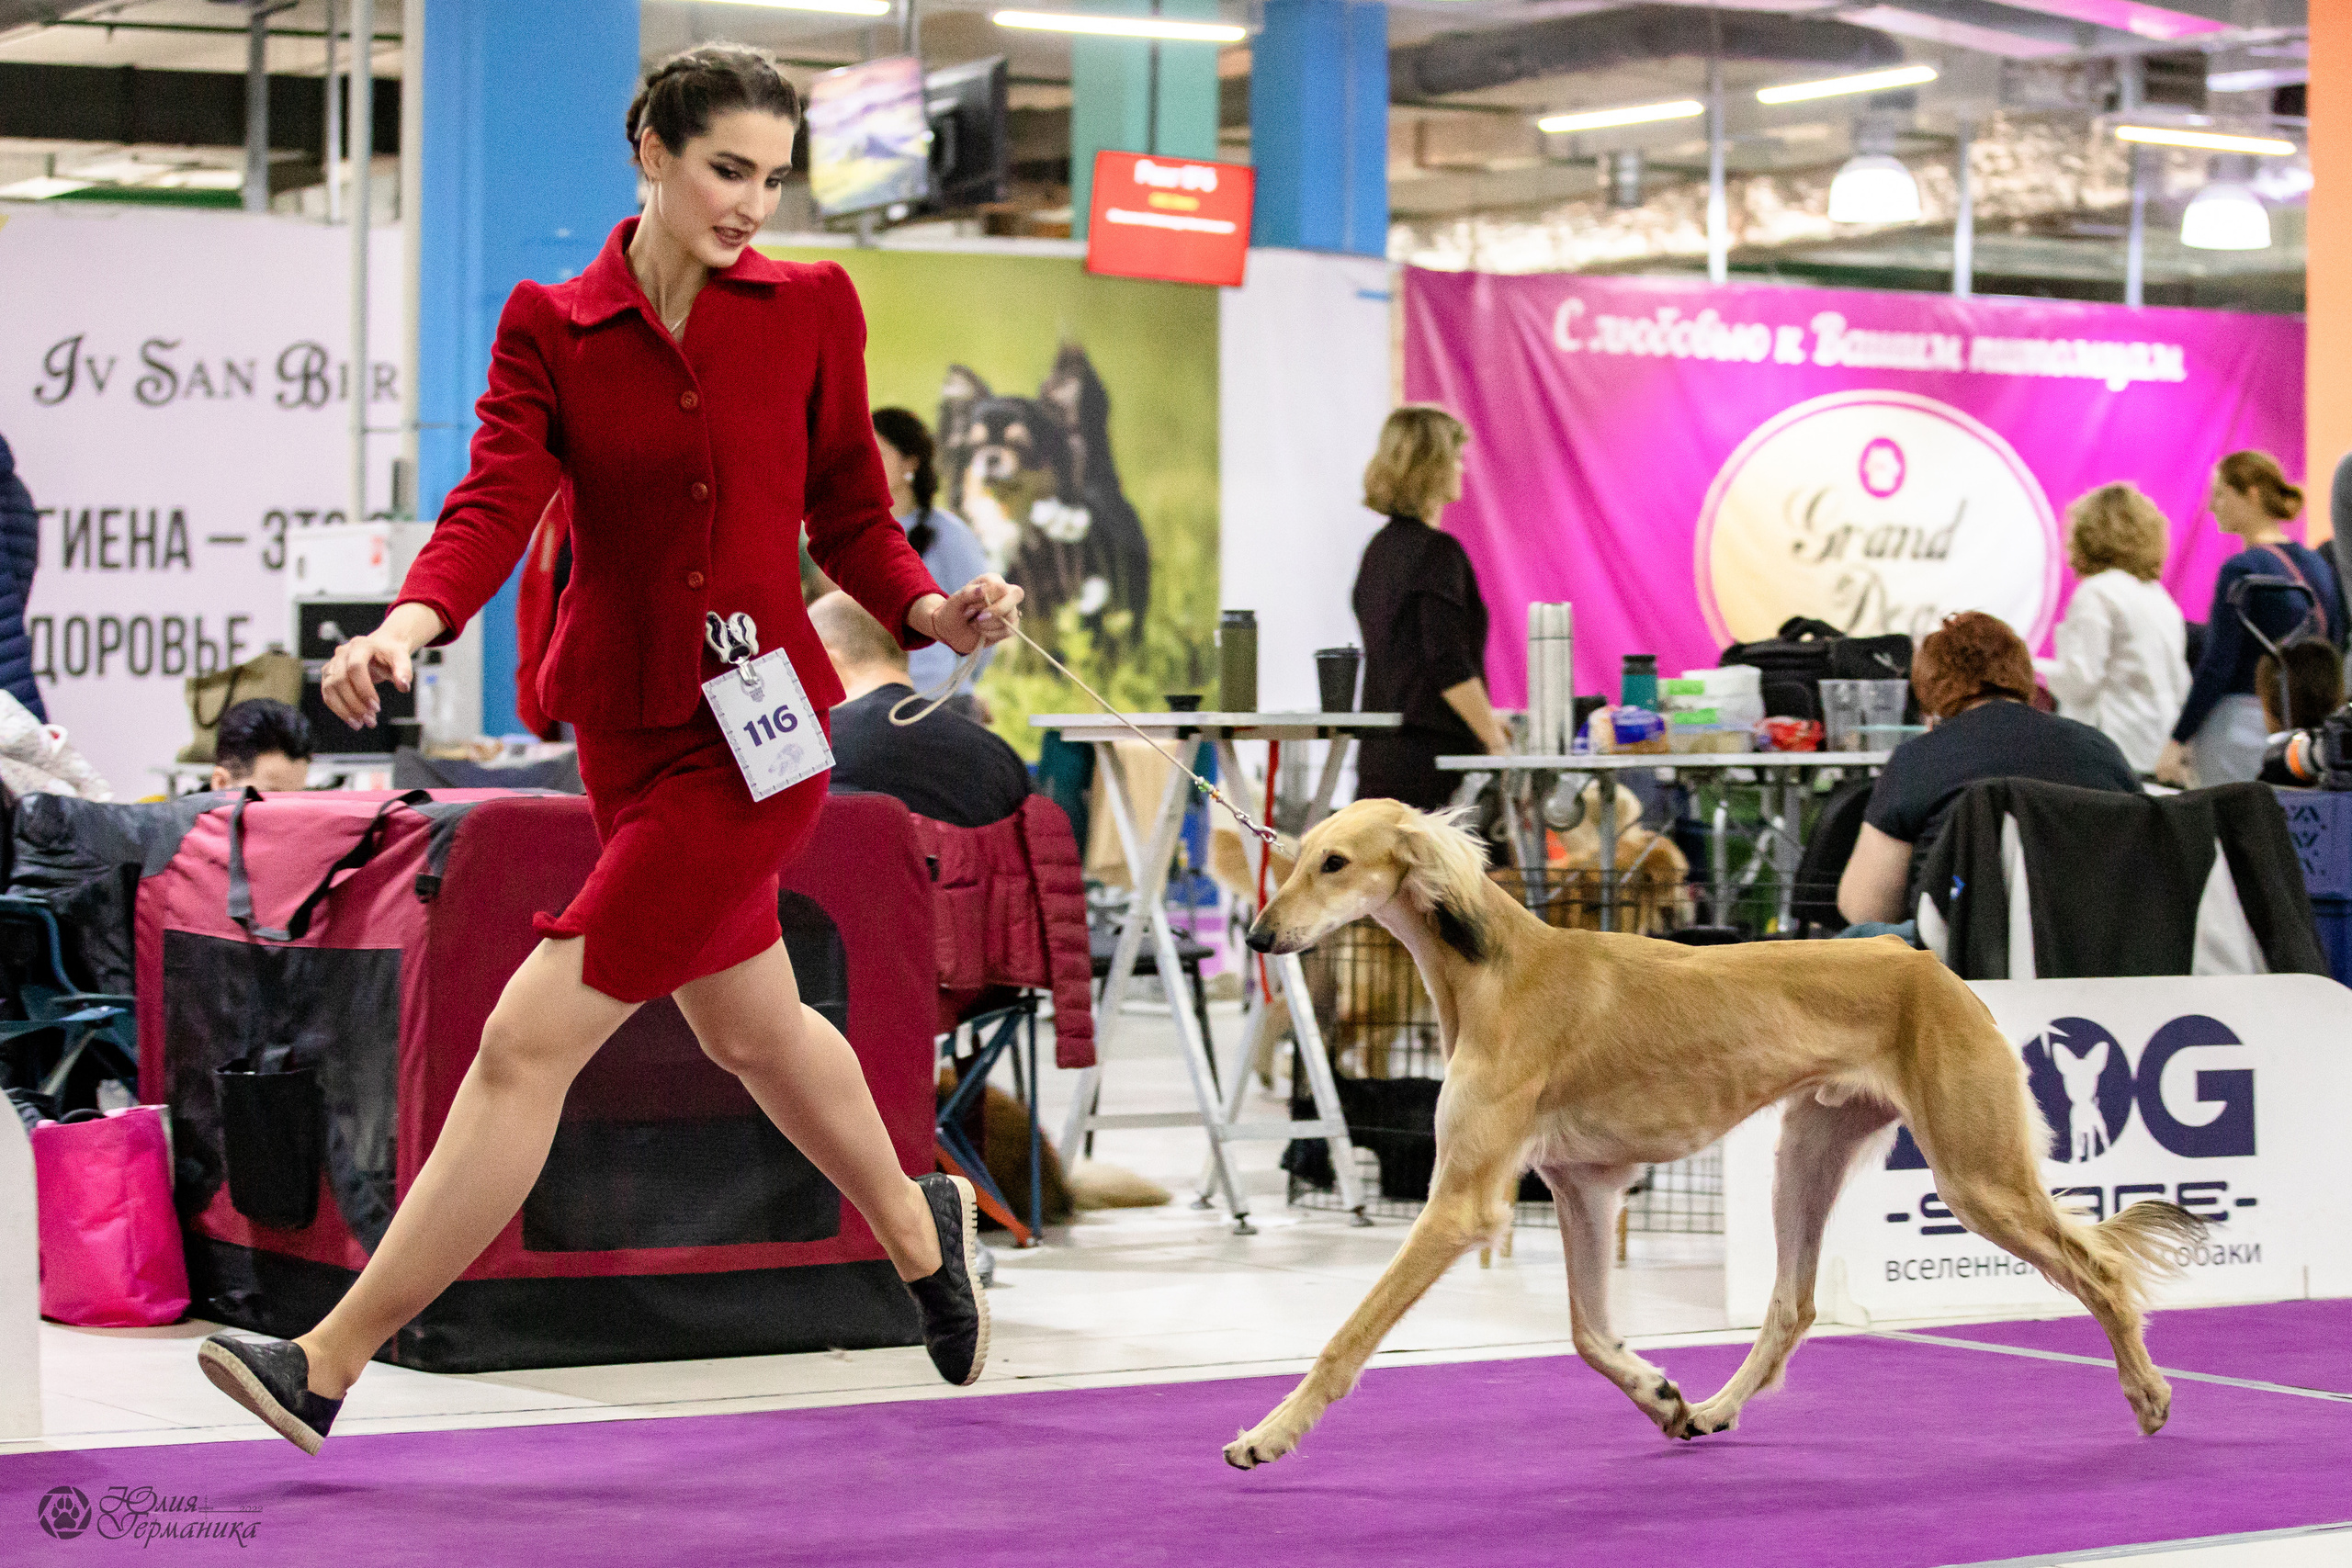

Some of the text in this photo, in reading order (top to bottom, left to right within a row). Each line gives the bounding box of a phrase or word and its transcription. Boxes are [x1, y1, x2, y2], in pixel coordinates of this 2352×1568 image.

[1782, 485, 1967, 564] Grand
[743, 705, 798, 747] 116
[1885, 1014, 2256, 1171] OG
[1886, 1240, 2263, 1282] вселенна обаки
